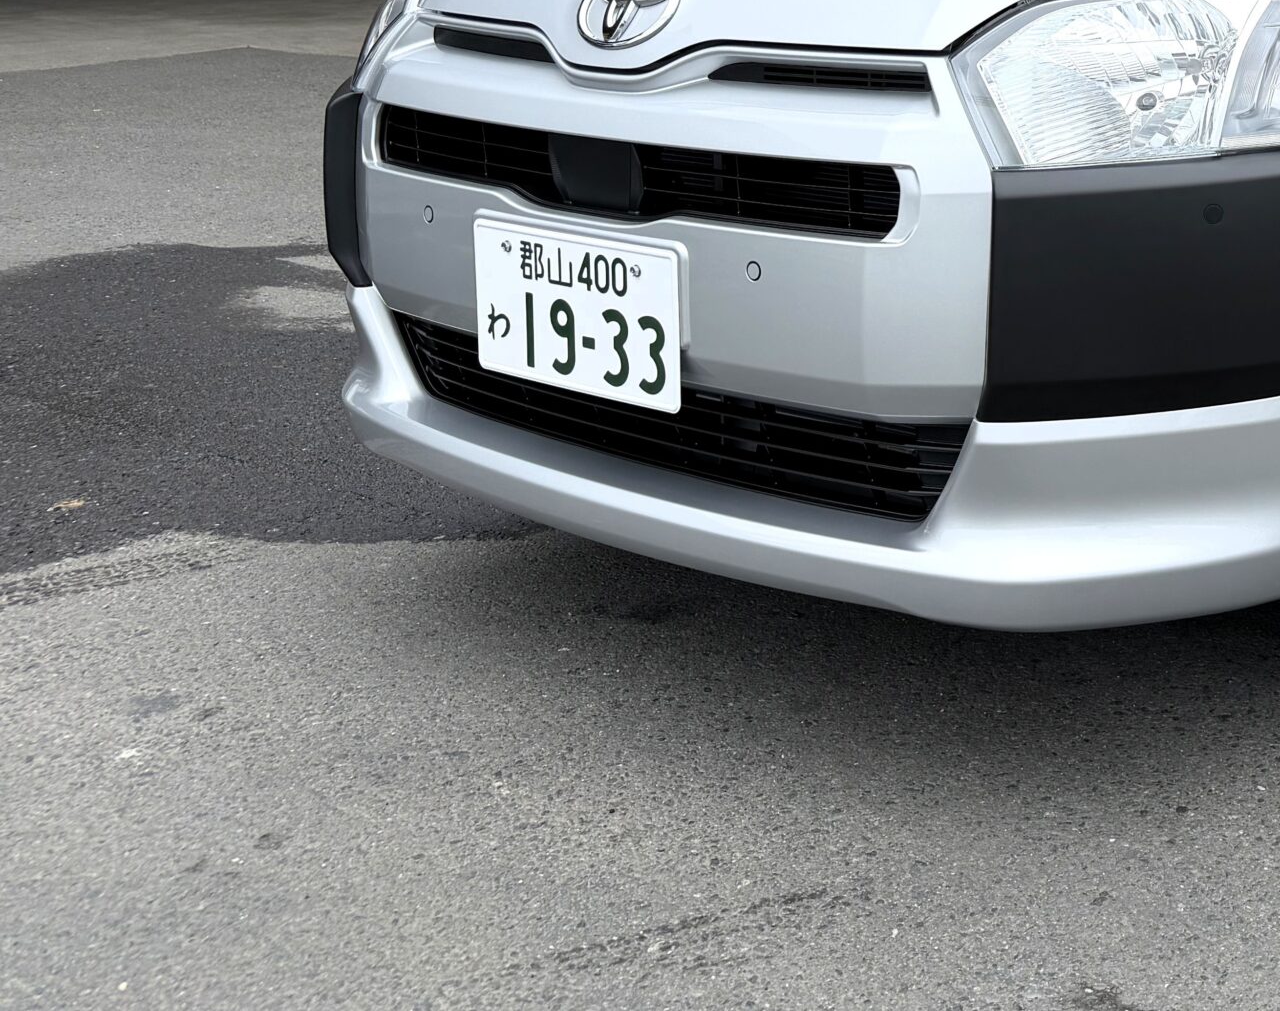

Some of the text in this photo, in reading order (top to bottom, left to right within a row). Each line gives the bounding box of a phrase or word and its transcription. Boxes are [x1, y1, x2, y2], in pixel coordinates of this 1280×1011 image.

[519, 240, 628, 297] 郡山400
[487, 303, 511, 340] わ
[525, 292, 666, 395] 19-33
